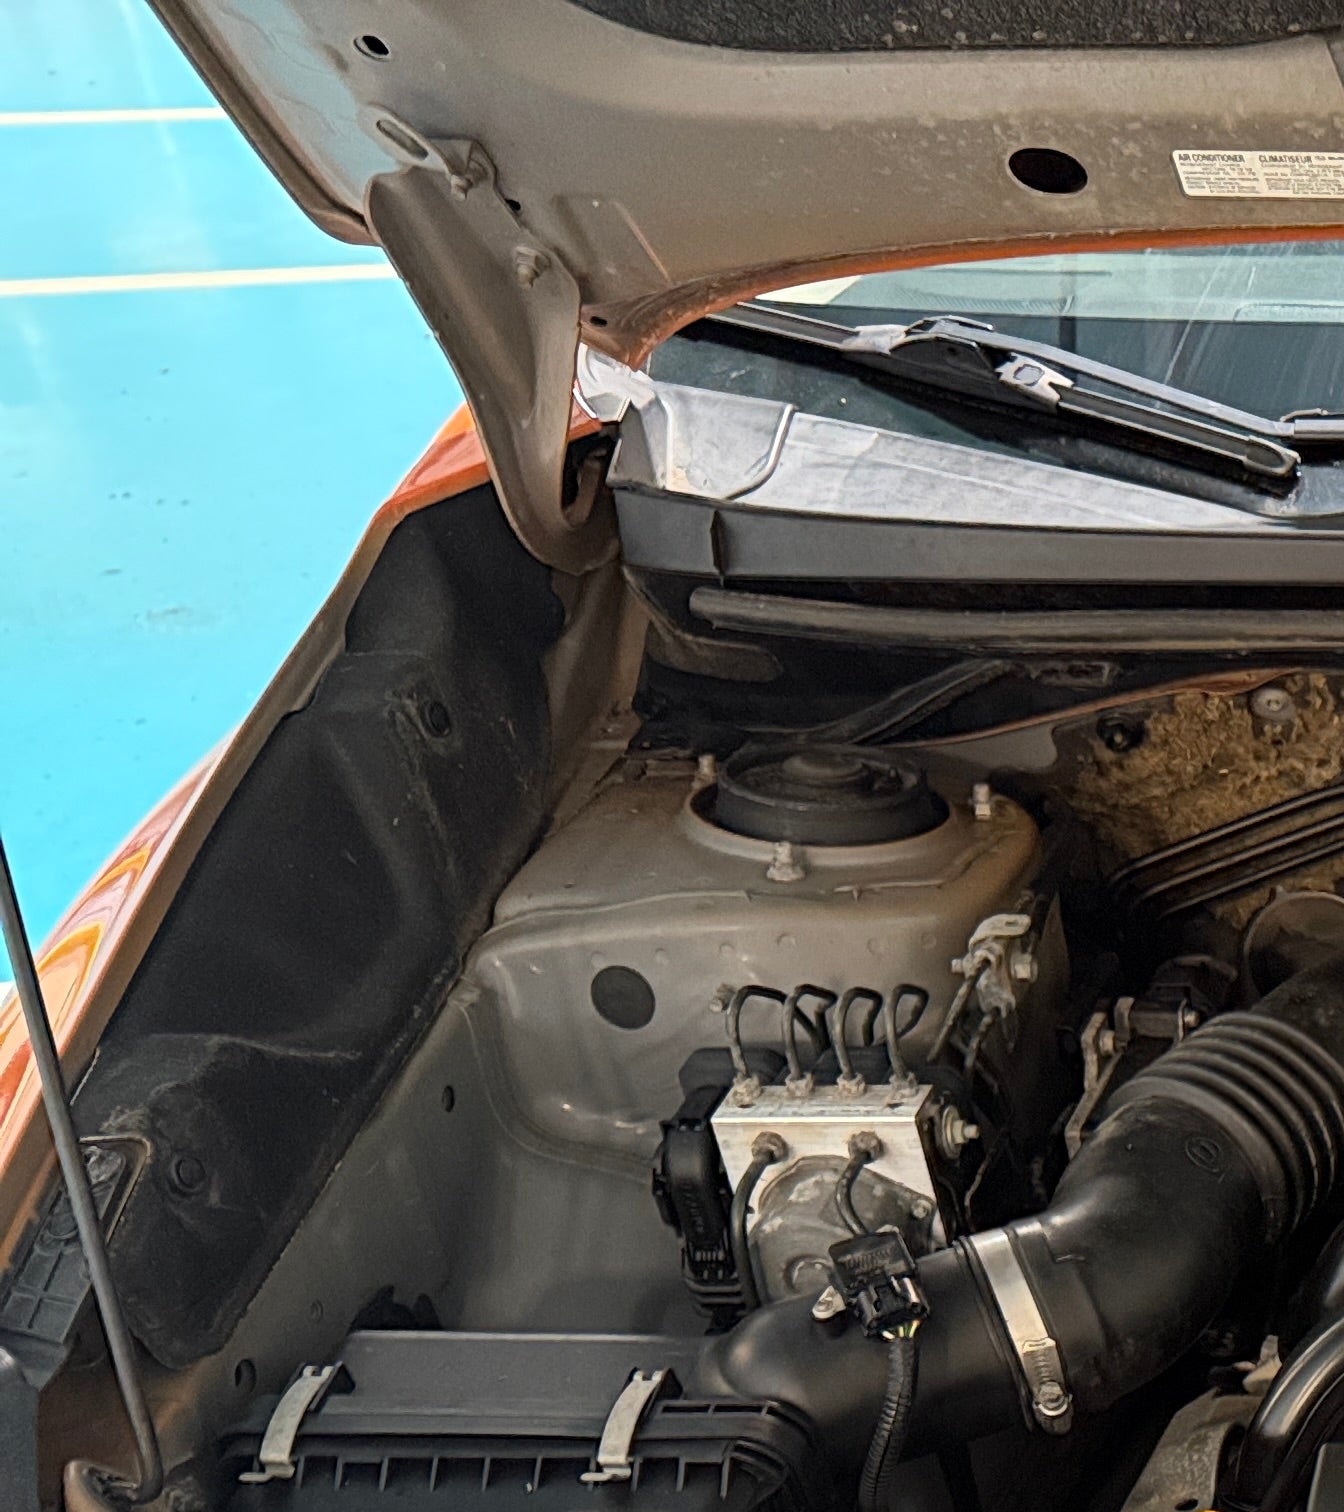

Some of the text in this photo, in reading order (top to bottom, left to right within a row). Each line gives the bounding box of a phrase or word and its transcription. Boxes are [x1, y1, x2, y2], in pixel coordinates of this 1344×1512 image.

[1178, 153, 1246, 163] AIR CONDITIONER
[1258, 154, 1313, 164] CLIMATISEUR
